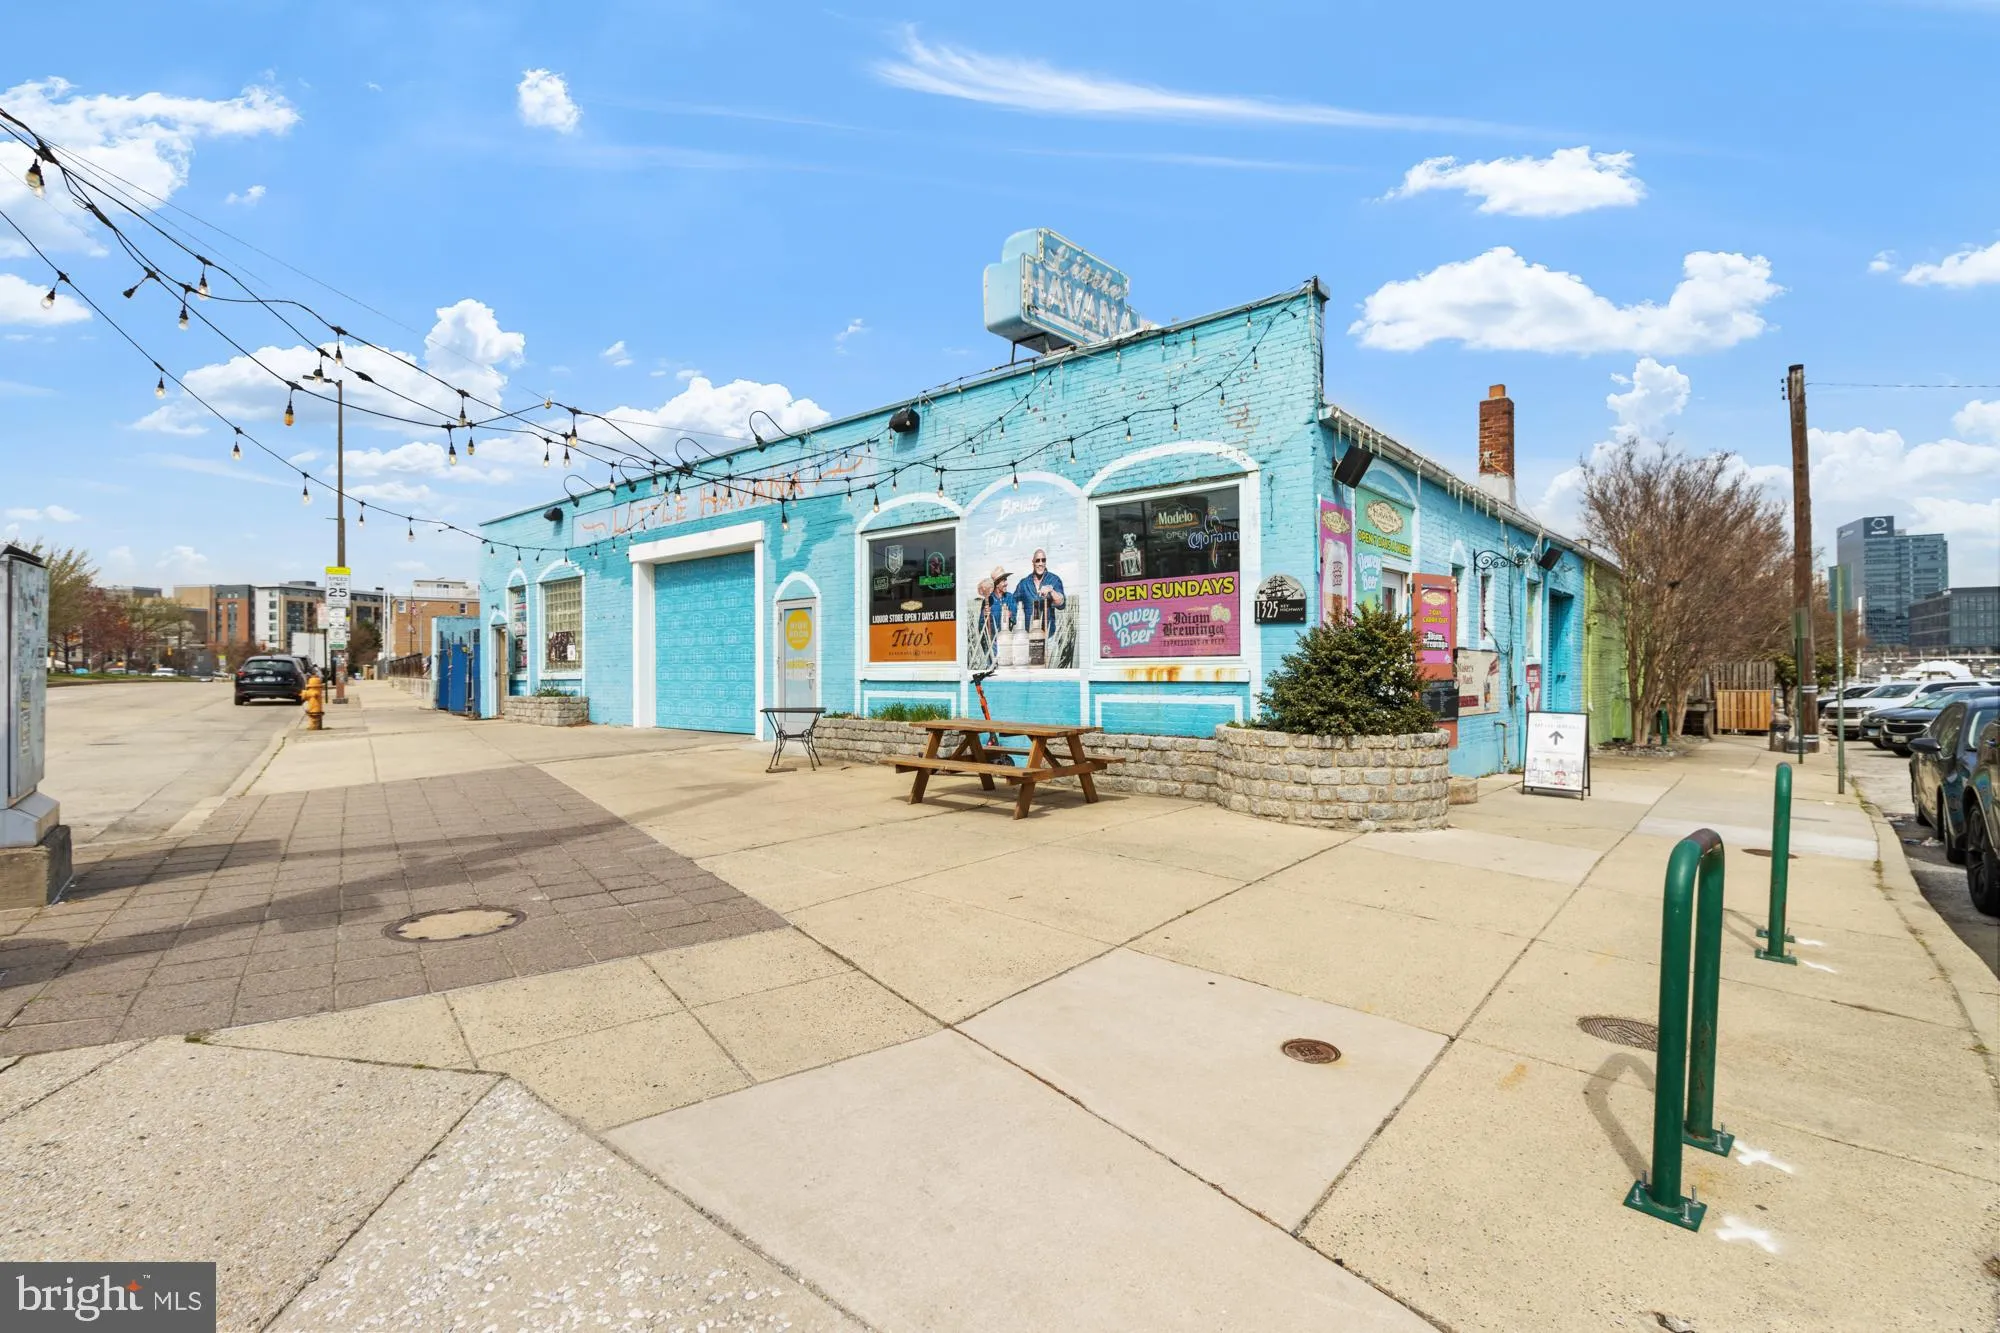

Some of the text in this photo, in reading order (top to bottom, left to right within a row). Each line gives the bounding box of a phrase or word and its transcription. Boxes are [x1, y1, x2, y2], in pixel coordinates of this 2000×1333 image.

[1025, 263, 1133, 338] HAVANA
[612, 471, 804, 534] LITTLE HAVANA
[1158, 509, 1193, 525] Modelo
[1166, 530, 1188, 539] OPEN
[1188, 530, 1239, 549] Corona
[1357, 552, 1381, 575] Dewey
[1103, 576, 1235, 603] OPEN SUNDAYS
[1362, 571, 1378, 592] Beer
[328, 588, 348, 598] 25
[872, 614, 889, 624] LIQUOR
[889, 613, 904, 623] STORE
[904, 612, 918, 622] OPEN
[922, 611, 934, 621] DAYS
[939, 610, 955, 620] WEEK
[1107, 607, 1161, 632] Dewey
[1172, 611, 1211, 625] Idiom
[1256, 601, 1279, 618] 1325
[891, 626, 934, 647] Tito's
[1117, 626, 1156, 648] Beer
[1162, 622, 1216, 637] Brewing
